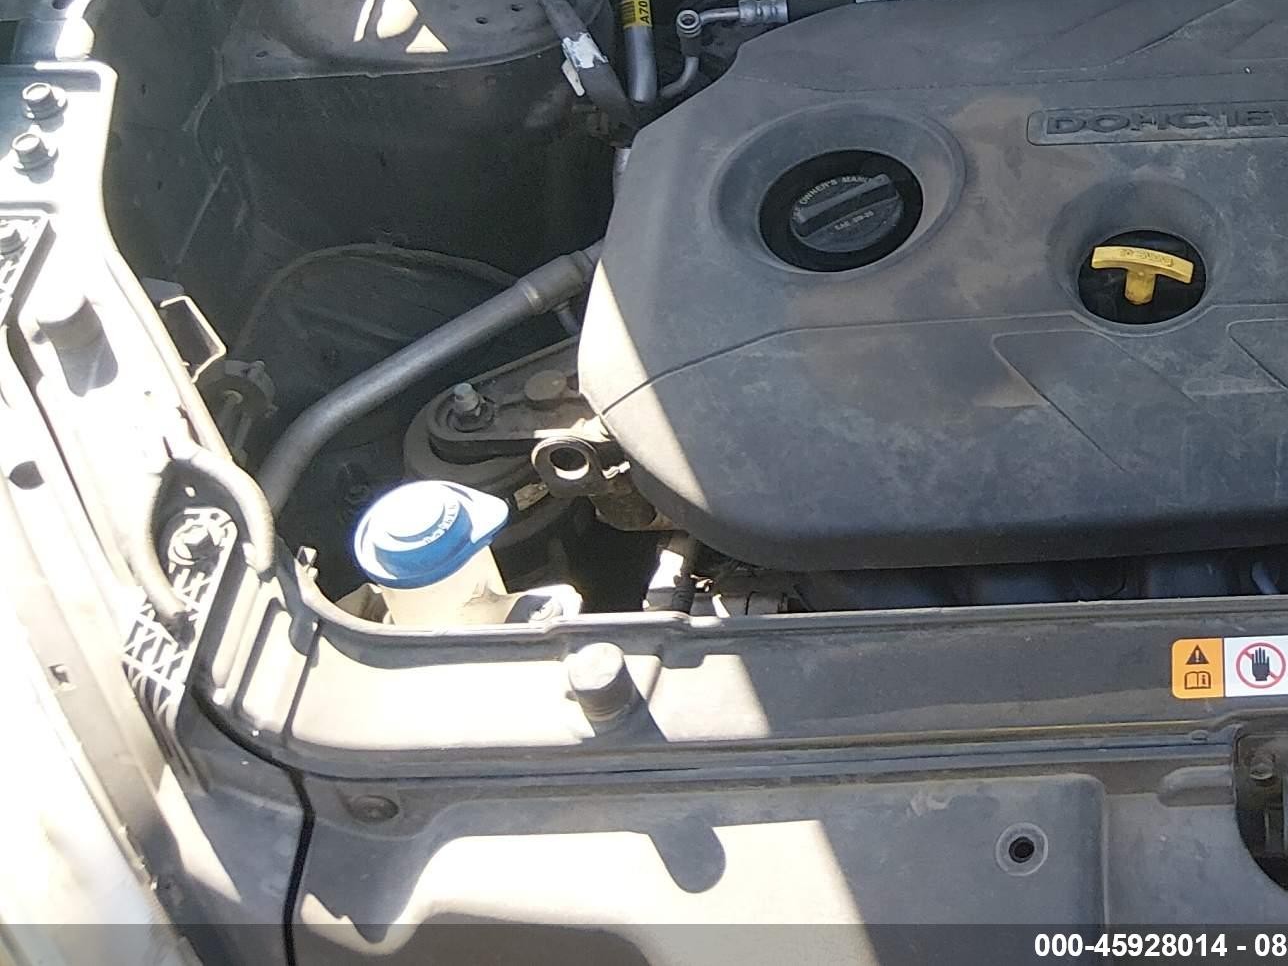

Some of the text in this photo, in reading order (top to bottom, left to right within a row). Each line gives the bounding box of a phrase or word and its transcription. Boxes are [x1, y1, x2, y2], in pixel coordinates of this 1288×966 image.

[638, 0, 650, 24] A70
[1046, 112, 1208, 135] DOHC
[799, 178, 838, 205] OWNER'S
